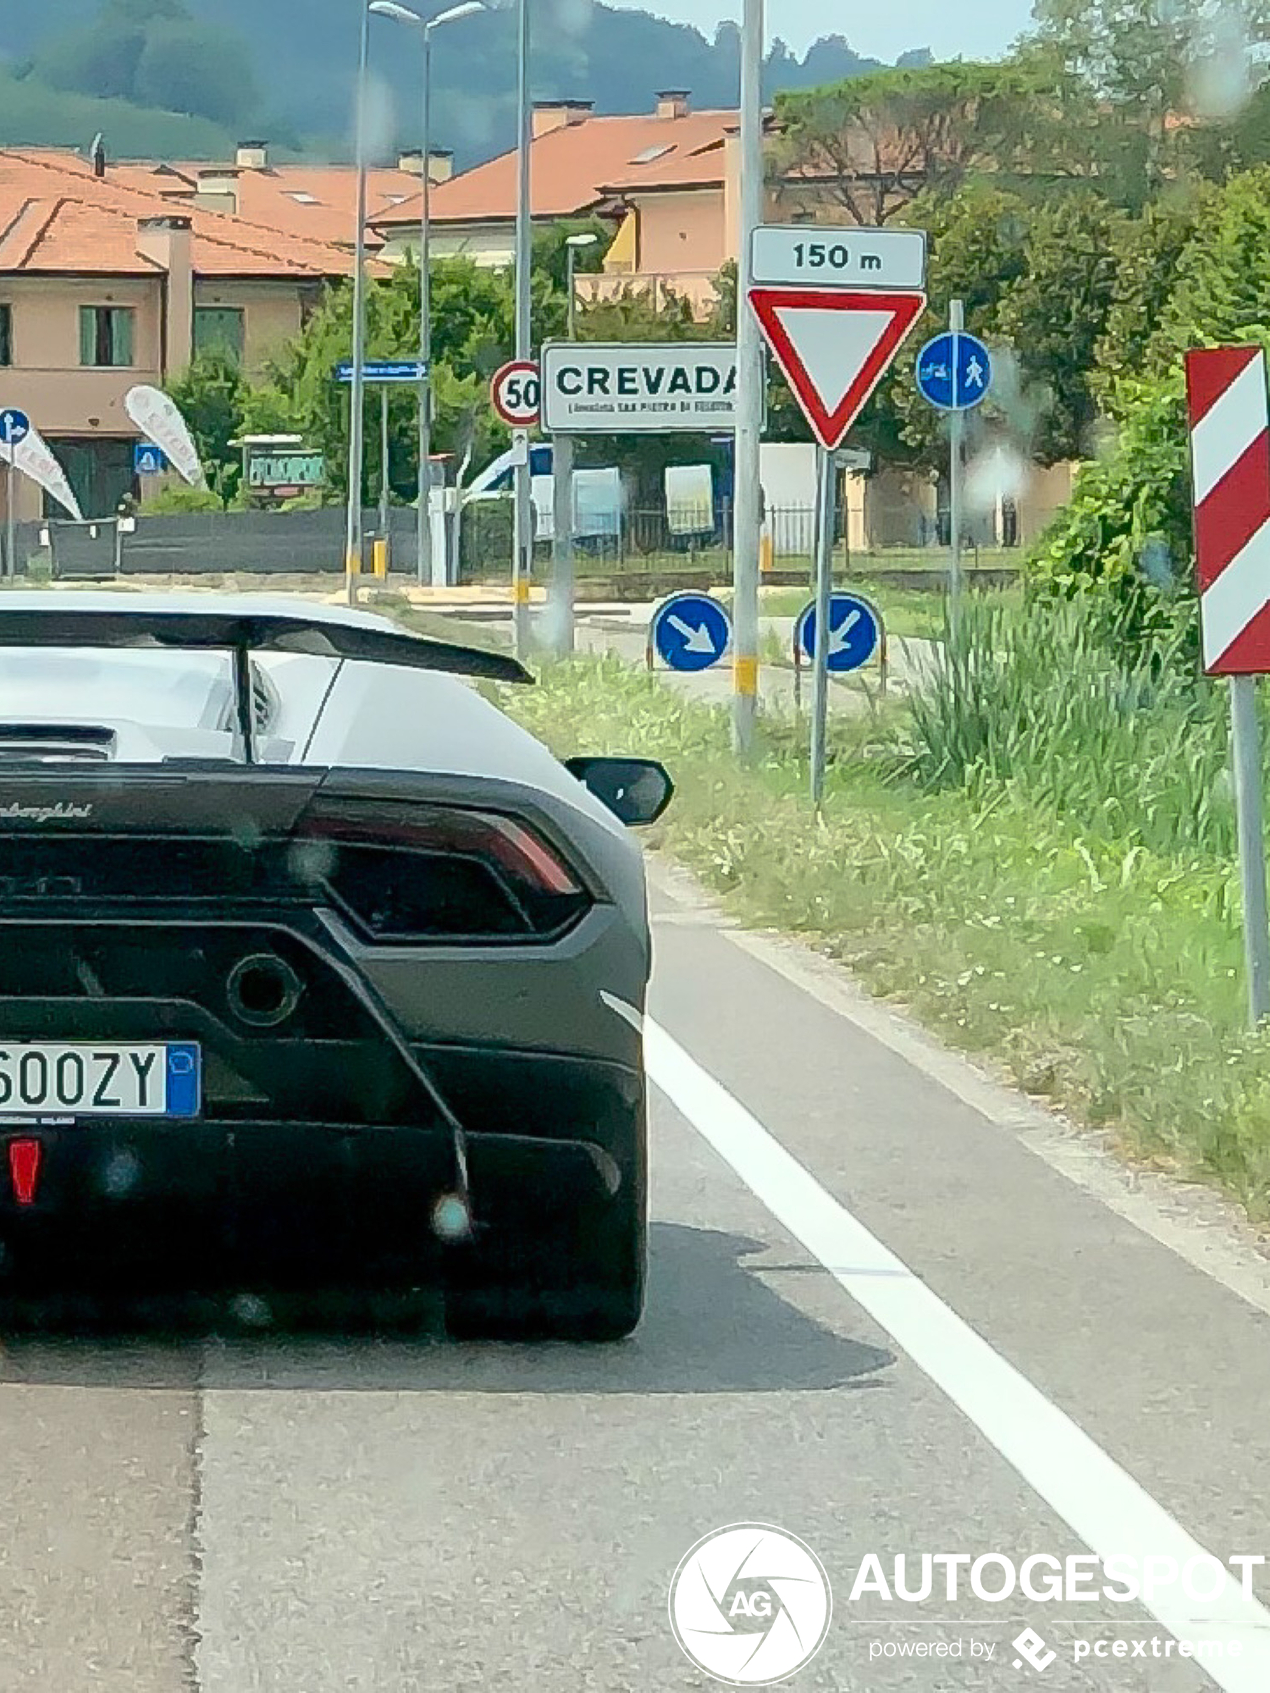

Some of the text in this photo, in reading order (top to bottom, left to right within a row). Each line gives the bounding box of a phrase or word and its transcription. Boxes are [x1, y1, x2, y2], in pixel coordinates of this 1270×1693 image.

[793, 242, 882, 270] 150 m
[505, 379, 541, 410] 50
